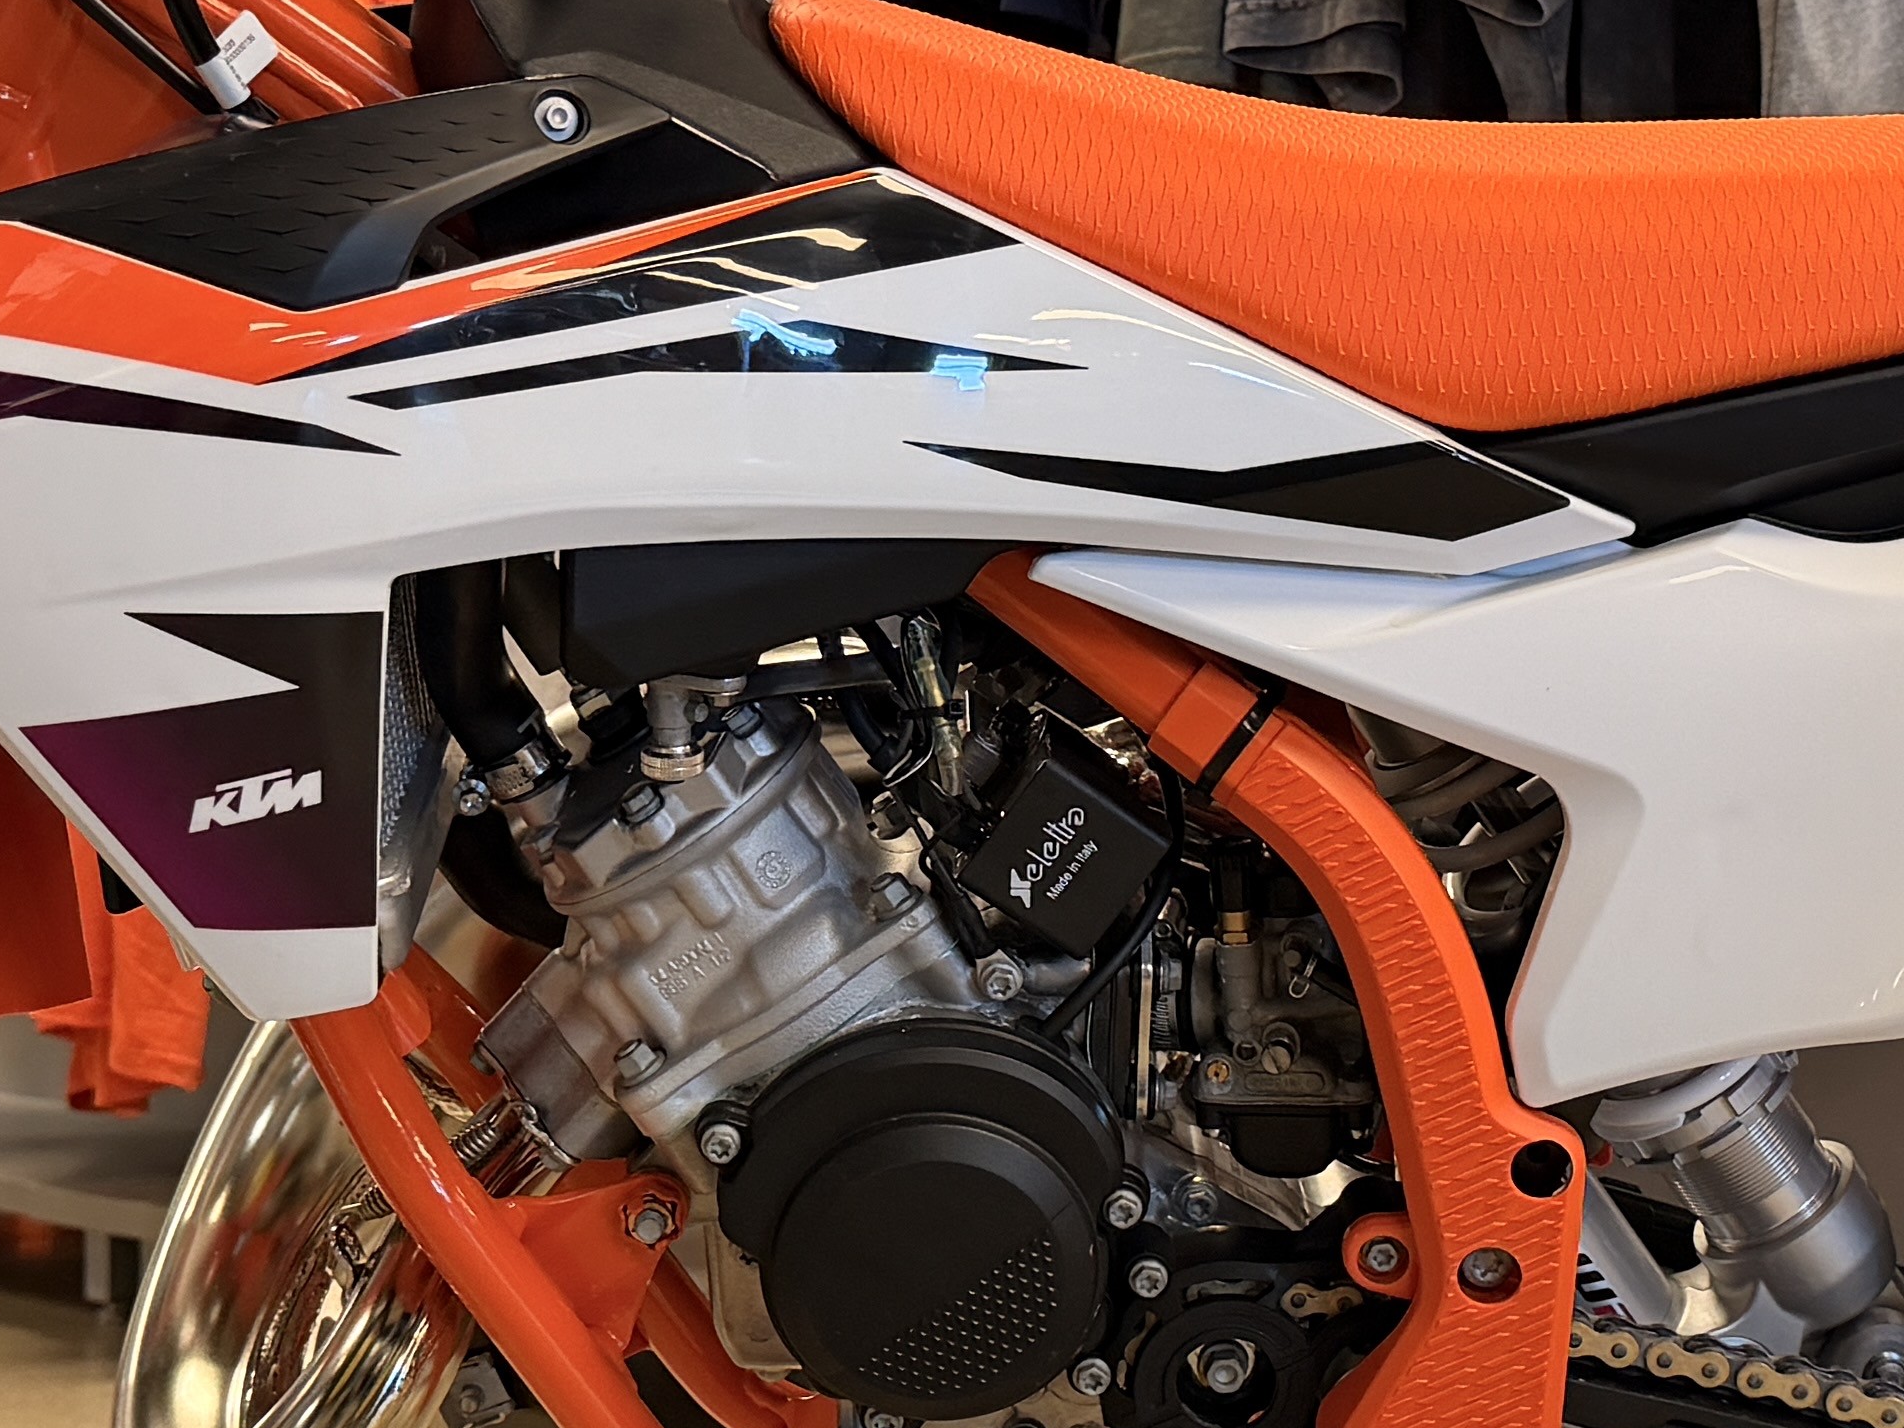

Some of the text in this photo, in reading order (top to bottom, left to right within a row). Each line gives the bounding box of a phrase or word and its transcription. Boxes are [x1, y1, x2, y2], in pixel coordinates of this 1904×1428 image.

[189, 768, 322, 834] KTM
[1046, 872, 1073, 900] Made
[1075, 840, 1099, 863] Italy
